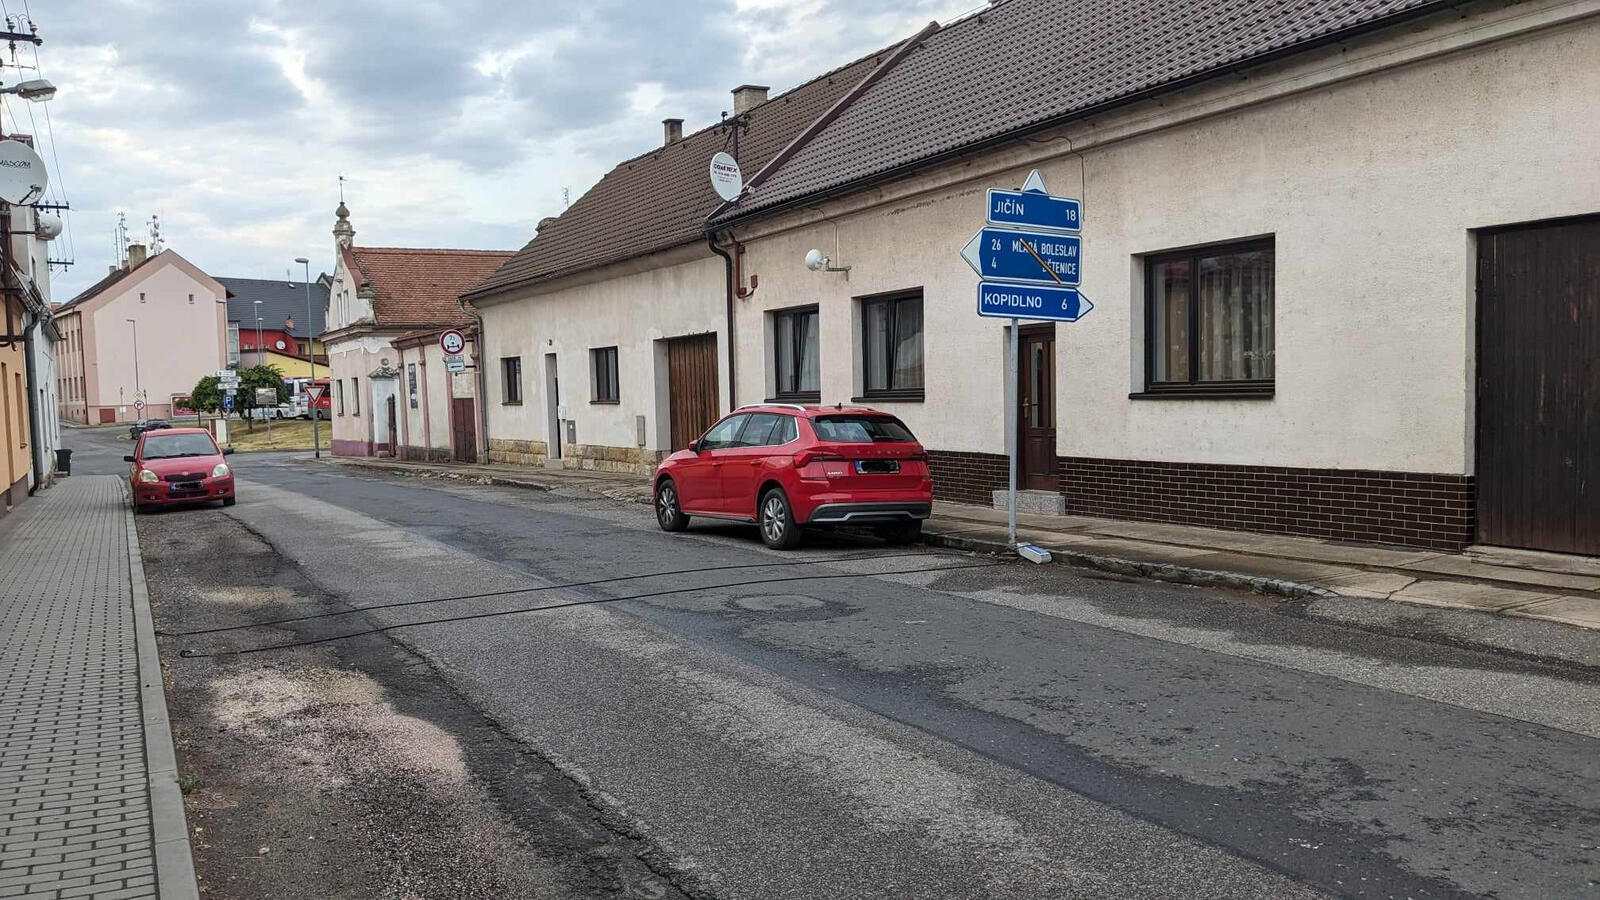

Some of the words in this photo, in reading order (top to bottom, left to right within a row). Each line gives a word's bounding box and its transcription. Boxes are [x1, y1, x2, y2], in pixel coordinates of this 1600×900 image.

[994, 199, 1024, 216] JIČÍN
[1065, 209, 1077, 222] 18
[991, 238, 1001, 251] 26
[1041, 243, 1077, 258] BOLESLAV
[991, 257, 997, 270] 4
[984, 292, 1042, 309] KOPIDLNO
[1061, 299, 1068, 310] 6
